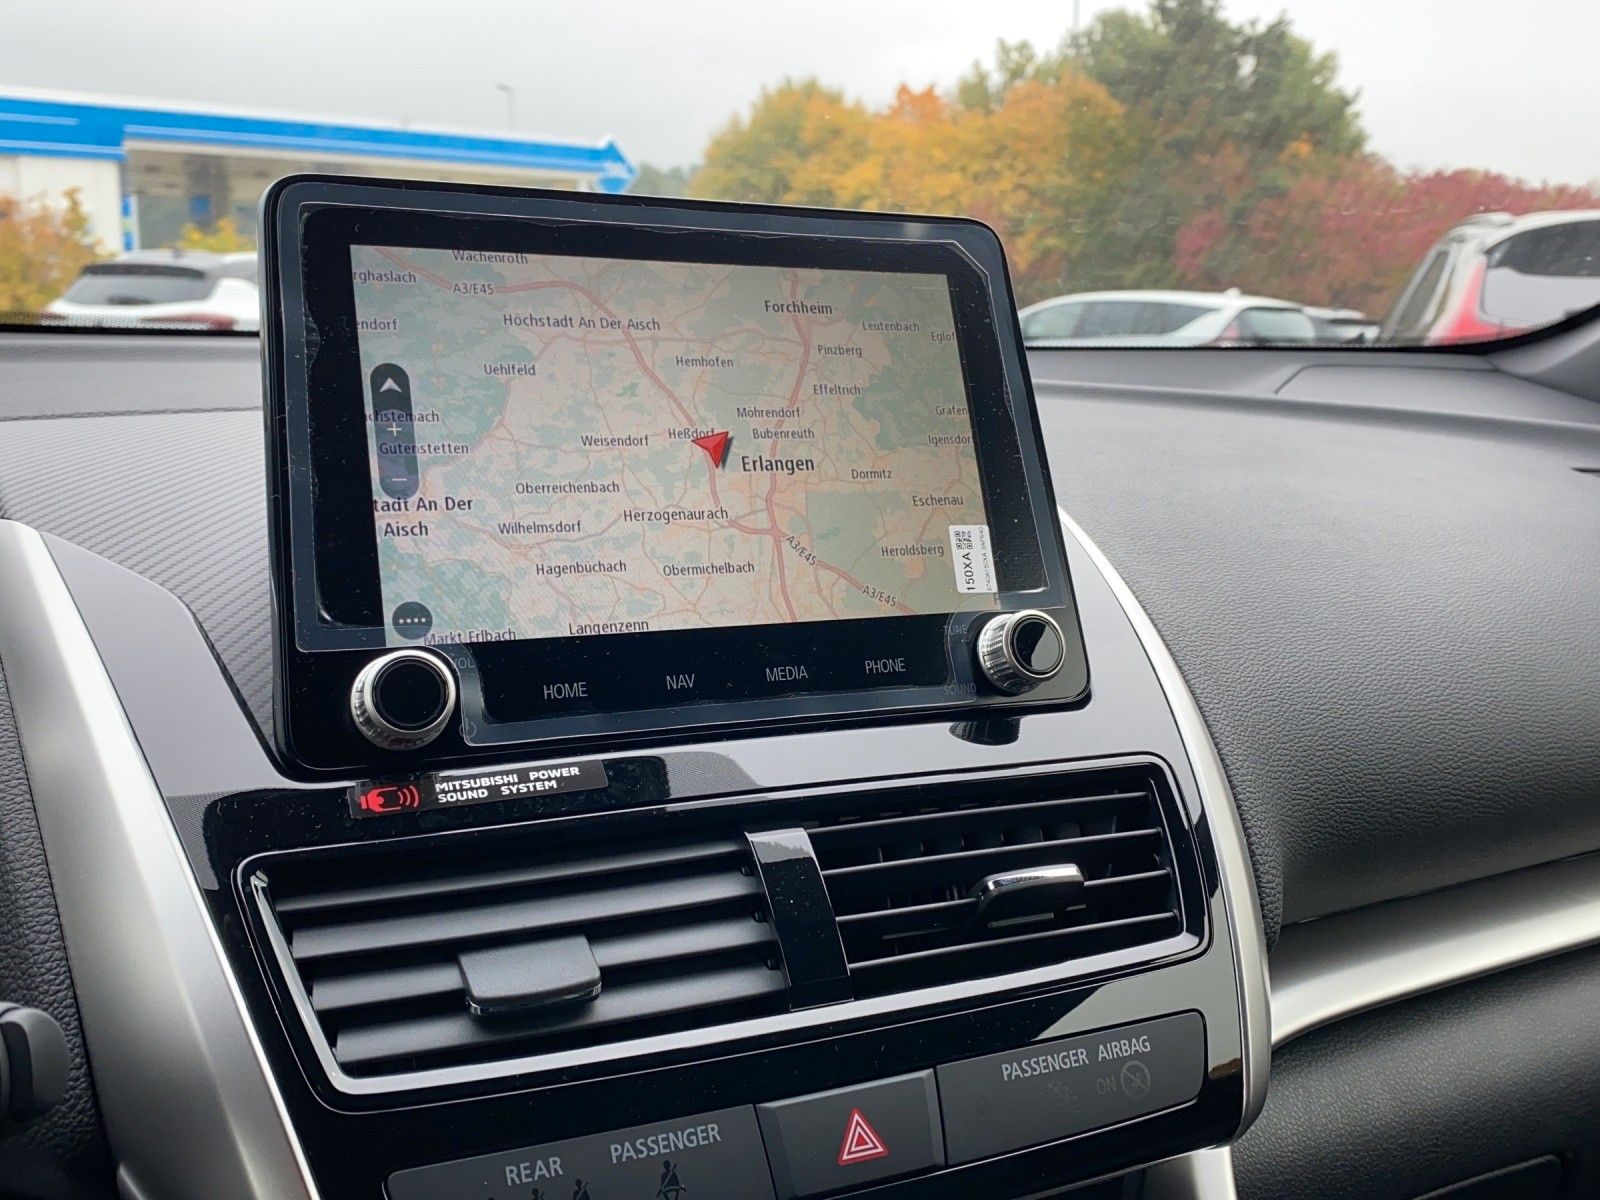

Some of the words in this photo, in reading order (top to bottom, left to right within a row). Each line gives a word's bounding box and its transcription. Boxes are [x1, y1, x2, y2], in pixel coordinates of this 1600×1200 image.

[452, 249, 528, 265] Wachenroth
[353, 269, 417, 285] rghaslach
[453, 282, 494, 295] A3/E45
[764, 300, 833, 314] Forchheim
[503, 313, 574, 329] Höchstadt
[578, 316, 597, 329] An
[600, 317, 623, 330] Der
[627, 317, 661, 332] Aisch
[862, 320, 920, 332] Leutenbach
[818, 344, 862, 358] Pinzberg
[484, 363, 537, 376] Uehlfeld
[676, 356, 734, 368] Hemhofen
[813, 383, 861, 395] Effeltrich
[736, 406, 800, 418] Möhrendorf
[935, 405, 968, 416] Grafen
[580, 434, 650, 447] Weisendorf
[668, 427, 715, 441] Heßdorf
[752, 428, 816, 440] Bubenreuth
[379, 441, 470, 455] Gutenstetten
[741, 455, 815, 475] Erlangen
[851, 468, 893, 480] Dormitz
[515, 480, 620, 495] Oberreichenbach
[416, 497, 438, 512] An
[445, 496, 473, 512] Der
[912, 494, 964, 507] Eschenau
[623, 506, 729, 525] Herzogenaurach
[383, 520, 430, 537] Aisch
[498, 520, 582, 535] Wilhelmsdorf
[786, 534, 818, 567] A3/E45
[881, 544, 945, 558] Heroldsberg
[535, 559, 628, 578] Hagenbüchach
[663, 561, 756, 577] Obermichelbach
[961, 552, 976, 591] 150XA
[862, 584, 897, 607] A3/E45
[568, 620, 650, 636] Langenzenn
[423, 631, 463, 646] Markt
[468, 627, 517, 643] Erlbach
[765, 665, 809, 682] MEDIA
[864, 657, 907, 675] PHONE
[665, 673, 696, 690] NAV
[542, 681, 588, 700] HOME
[435, 773, 519, 793] MITSUBISHI
[528, 766, 581, 781] POWER
[437, 788, 489, 803] SOUND
[500, 779, 558, 796] SYSTEM
[1001, 1047, 1090, 1082] PASSENGER
[1097, 1035, 1151, 1062] AIRBAG
[609, 1122, 722, 1165] PASSENGER
[505, 1155, 564, 1187] REAR
